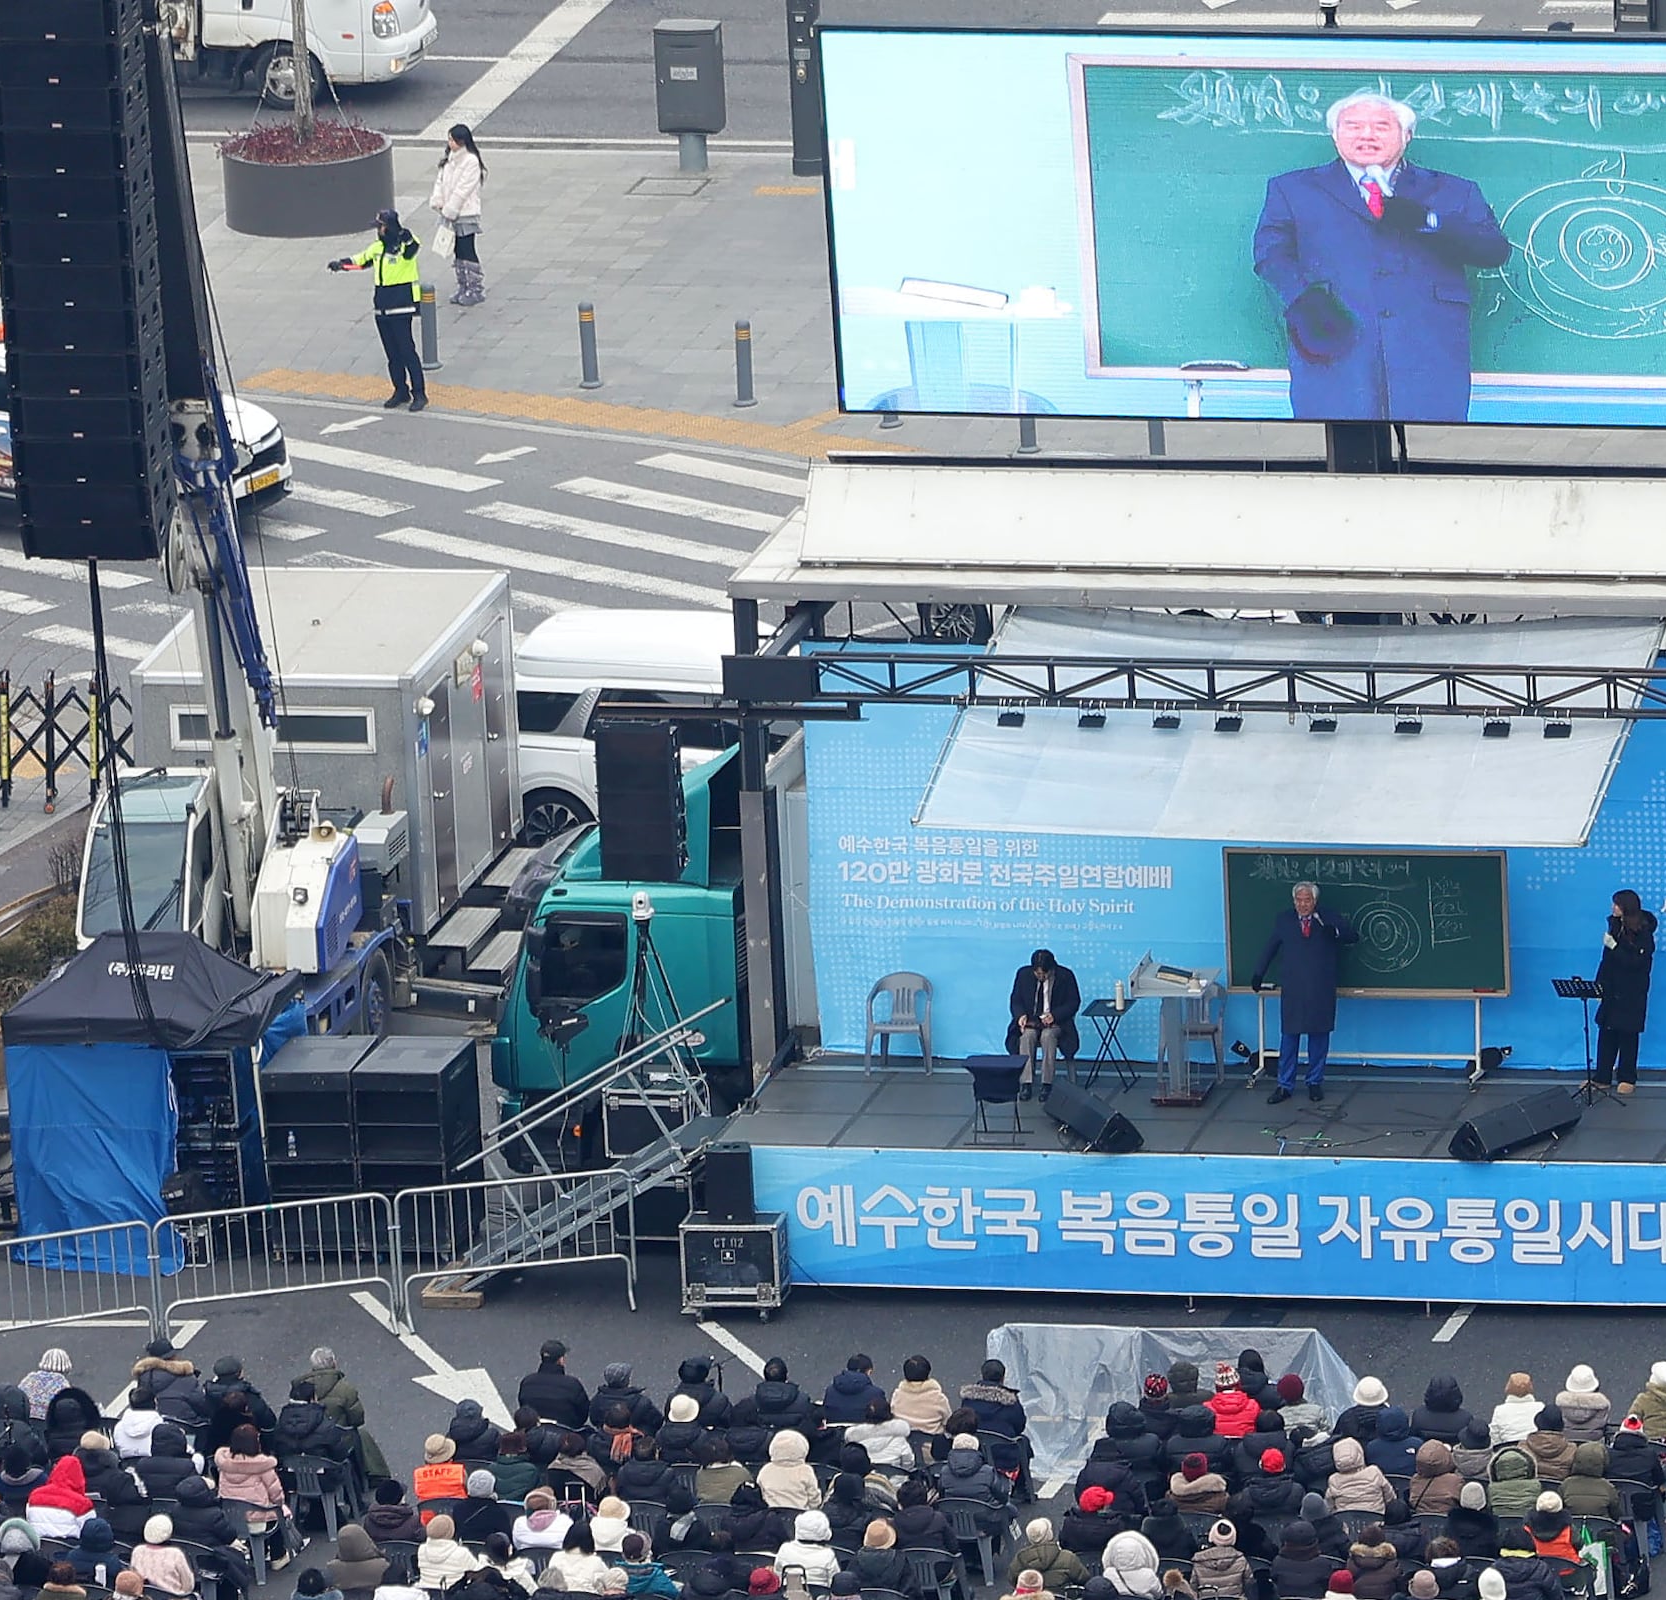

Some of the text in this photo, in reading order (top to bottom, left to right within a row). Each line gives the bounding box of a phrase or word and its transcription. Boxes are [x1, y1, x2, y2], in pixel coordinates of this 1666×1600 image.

[838, 835, 1039, 858] 예수한국 복음통일을 위한
[838, 860, 1173, 890] 120만 광화문 전국주일연합예배
[841, 893, 1136, 916] The Demonstration of the Holy Spirit
[107, 961, 175, 981] (주)리턴
[796, 1184, 1042, 1253] 예수한국
[1057, 1188, 1303, 1259] 복음통일
[423, 1468, 452, 1478] STAFF
